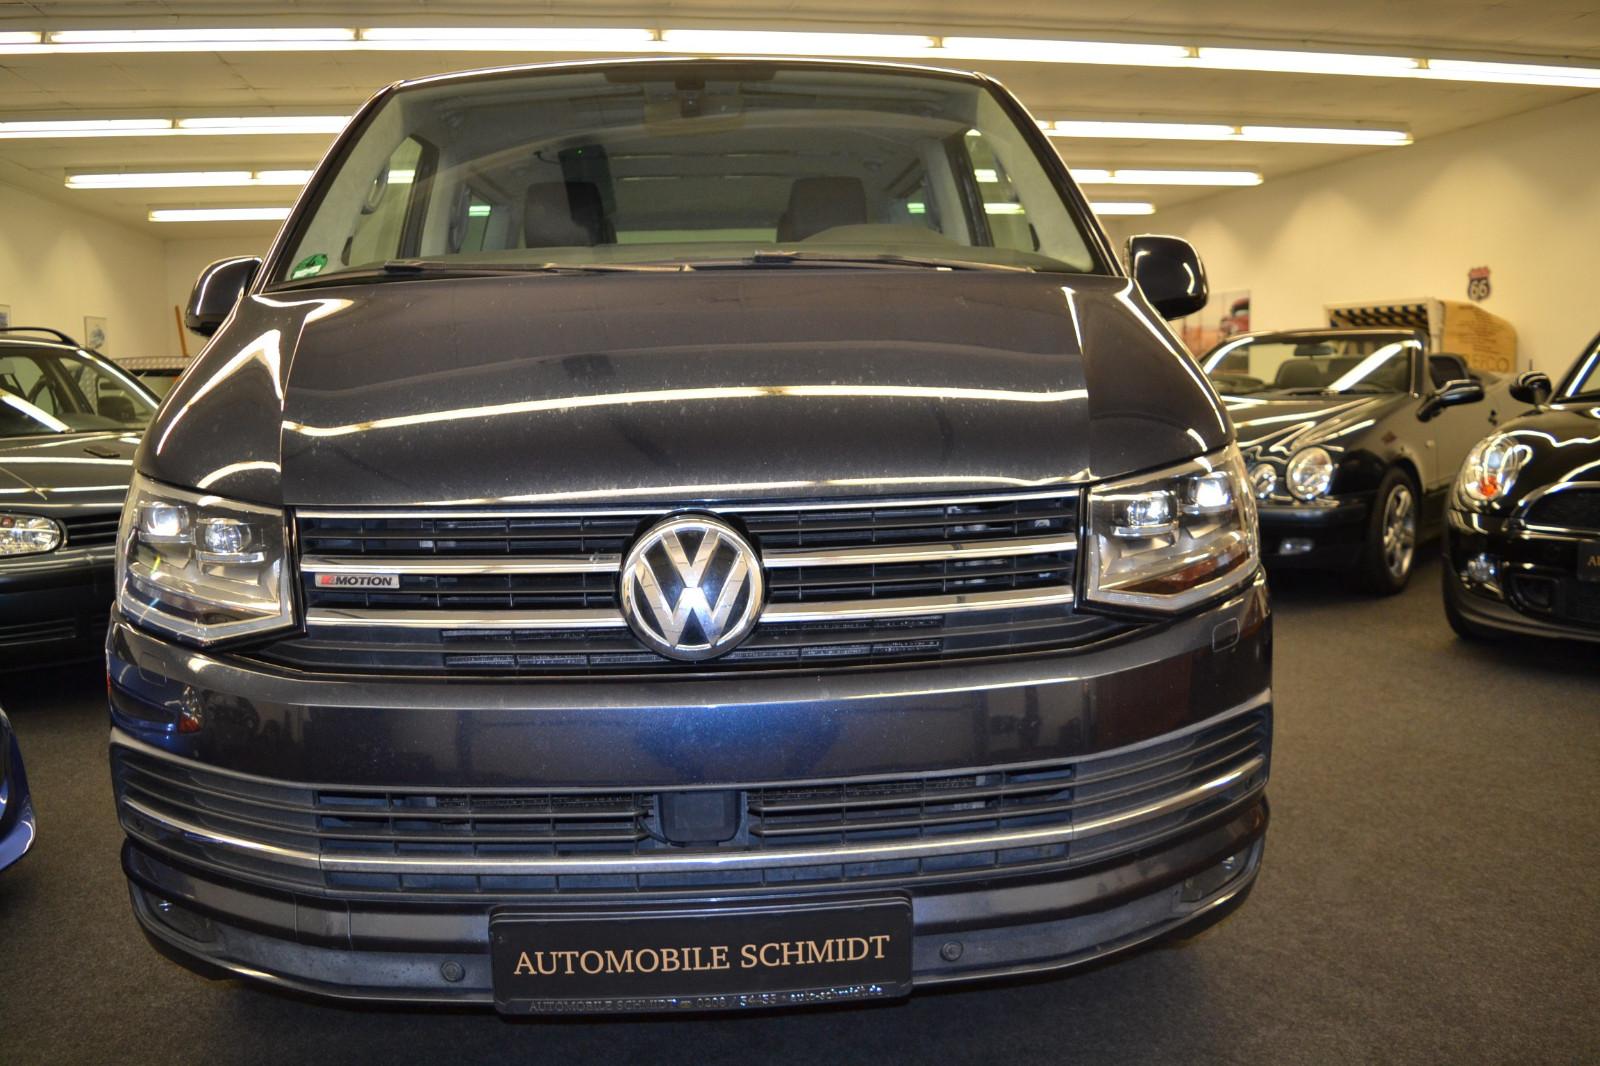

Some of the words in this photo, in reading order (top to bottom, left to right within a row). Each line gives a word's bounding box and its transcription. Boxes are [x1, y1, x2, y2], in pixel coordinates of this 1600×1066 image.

[1469, 280, 1488, 299] 66
[634, 528, 750, 648] VW
[513, 946, 731, 975] AUTOMOBILE
[741, 935, 891, 969] SCHMIDT
[529, 1000, 612, 1012] AUTOMOBILE
